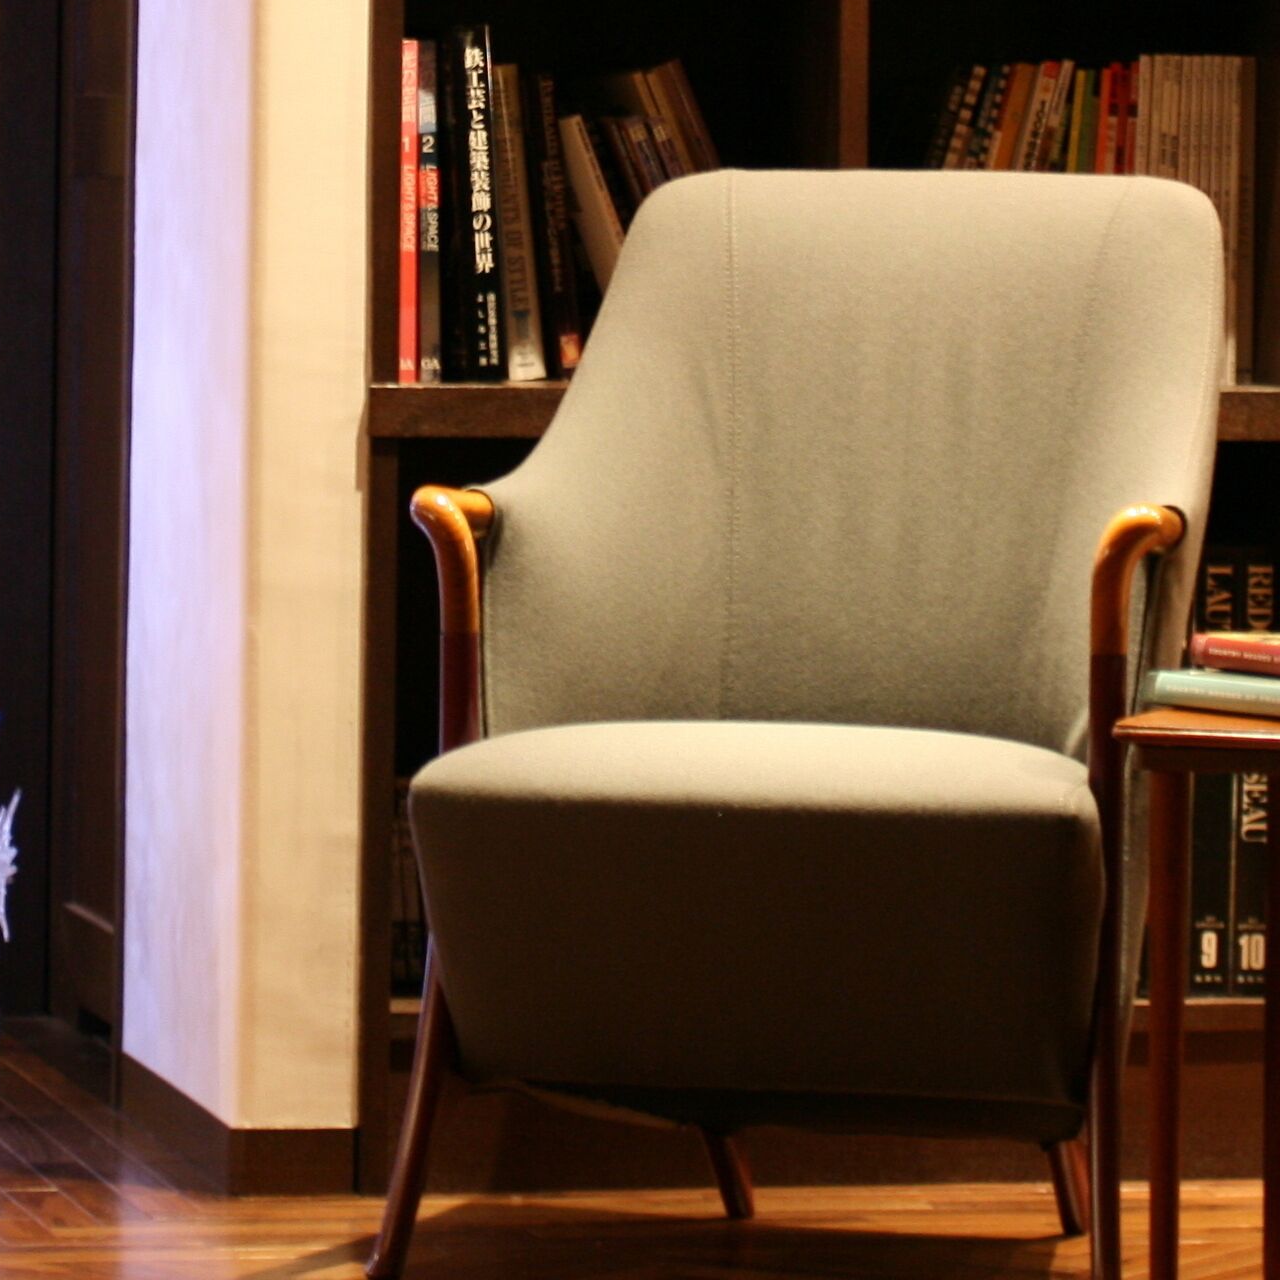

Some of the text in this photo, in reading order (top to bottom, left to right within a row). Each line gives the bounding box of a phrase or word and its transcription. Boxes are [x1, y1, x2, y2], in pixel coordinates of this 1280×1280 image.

[402, 135, 411, 154] 1
[421, 134, 435, 154] 2
[426, 211, 440, 252] SPACE
[1205, 564, 1233, 631] LAU
[1201, 930, 1217, 968] 9
[1238, 932, 1266, 970] 10
